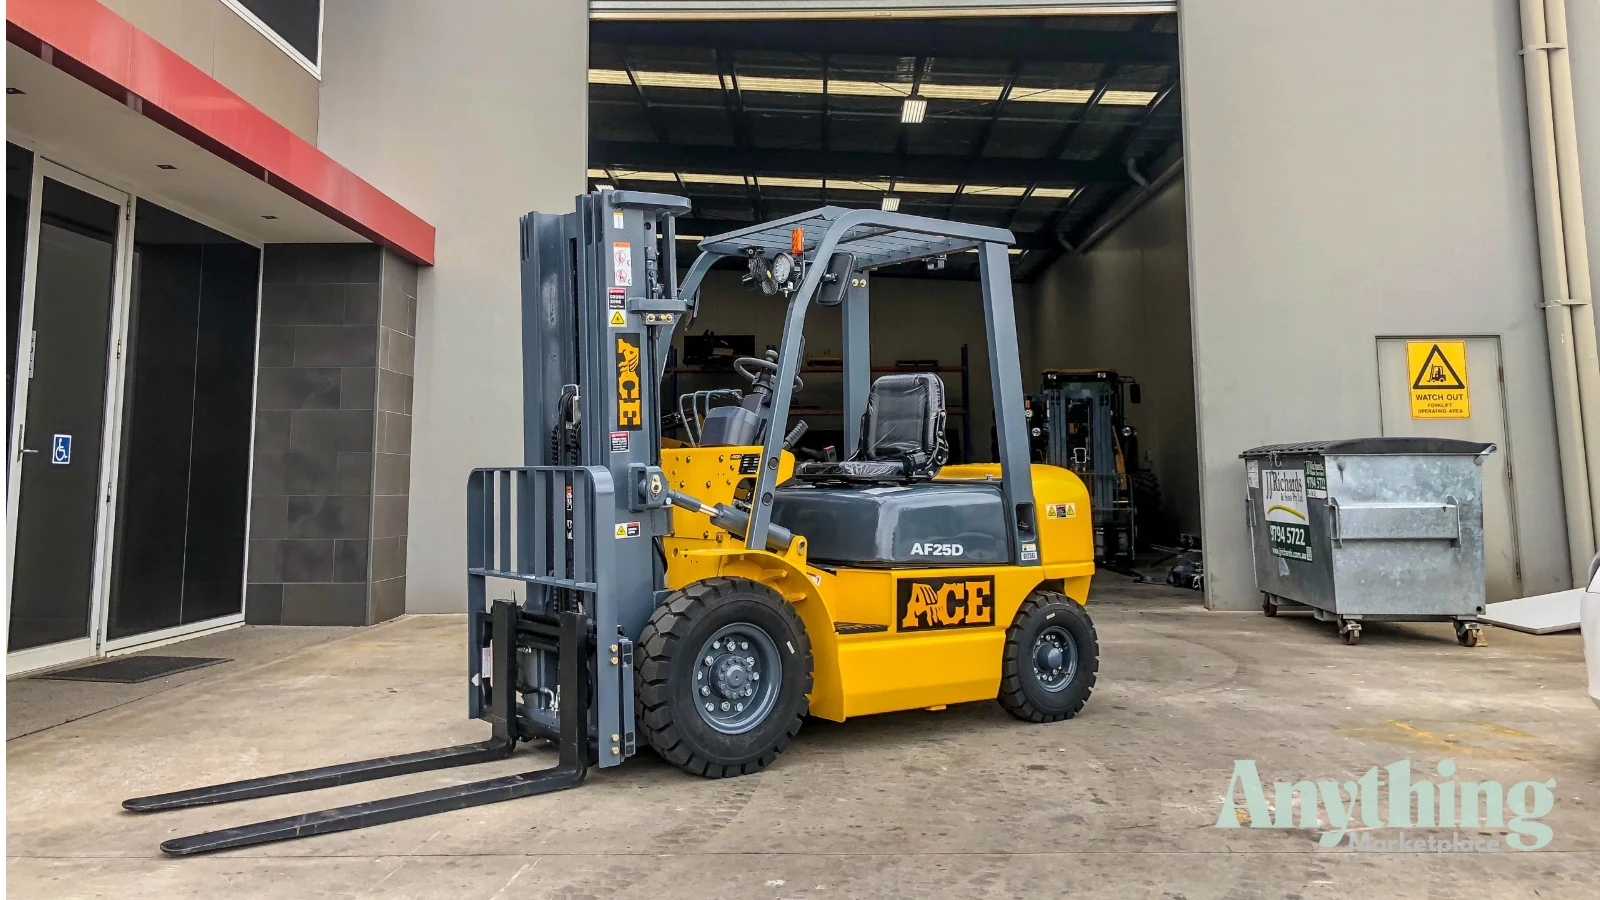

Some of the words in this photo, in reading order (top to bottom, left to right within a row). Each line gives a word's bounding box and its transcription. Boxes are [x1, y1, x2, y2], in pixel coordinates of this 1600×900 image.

[618, 338, 641, 426] ACE
[910, 542, 964, 557] AF25D
[1269, 525, 1286, 543] 9794
[1286, 527, 1306, 546] 5722
[902, 580, 991, 629] ACE
